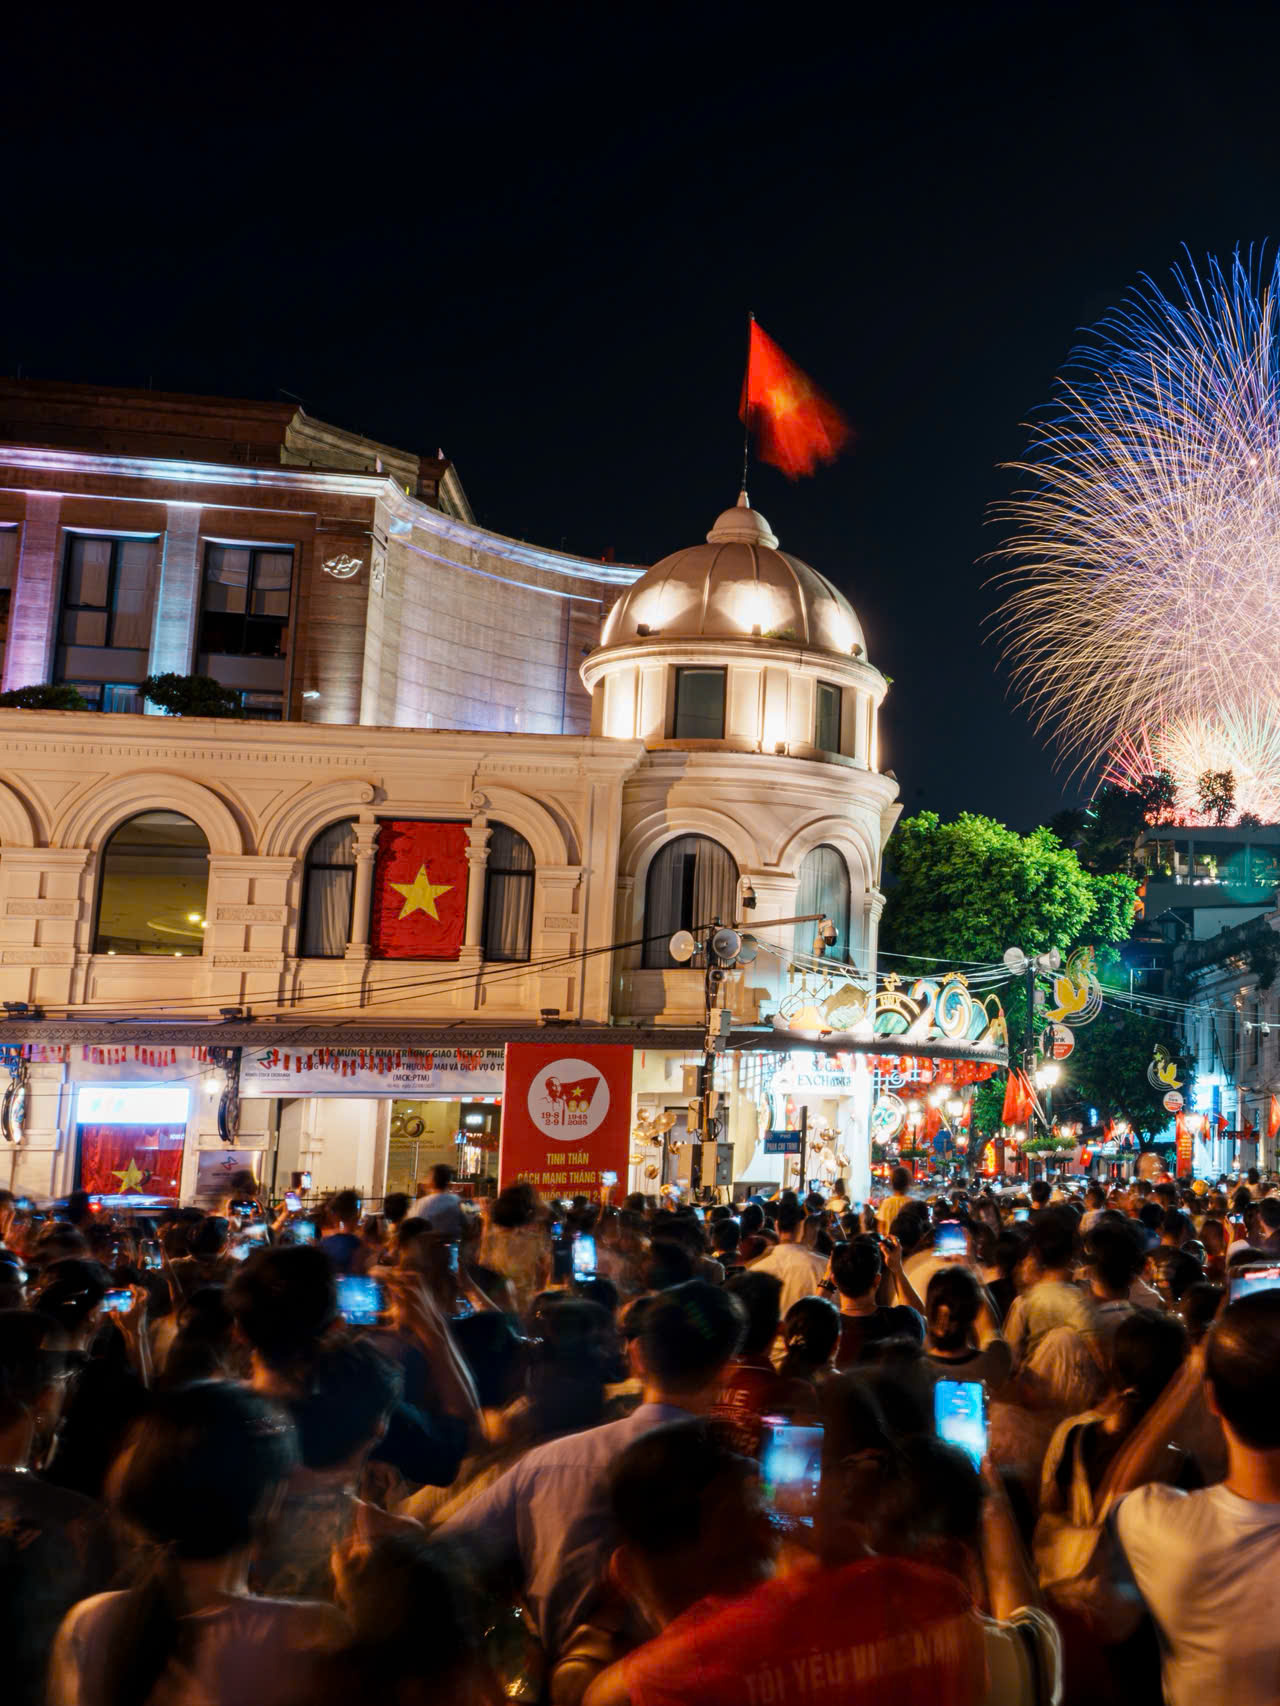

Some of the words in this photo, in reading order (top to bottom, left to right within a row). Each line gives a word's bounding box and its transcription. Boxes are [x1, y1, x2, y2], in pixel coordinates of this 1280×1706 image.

[375, 1049, 394, 1057] KHAI
[432, 1049, 451, 1058] GIAO
[546, 1153, 565, 1165] TINH
[569, 1169, 595, 1183] THÁNG
